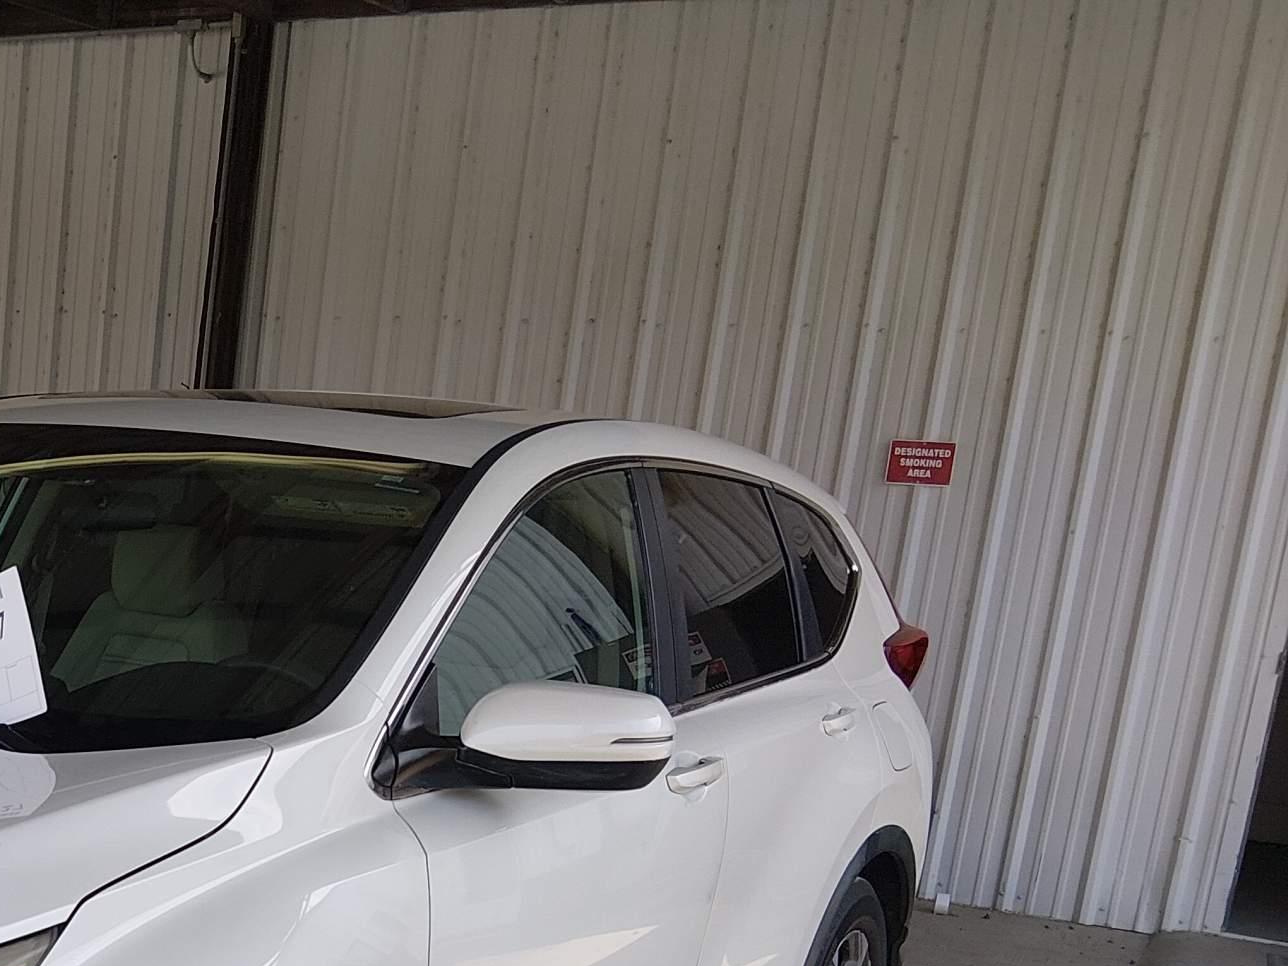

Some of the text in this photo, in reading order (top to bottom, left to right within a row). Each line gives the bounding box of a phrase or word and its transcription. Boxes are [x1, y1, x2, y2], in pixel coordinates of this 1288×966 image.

[894, 447, 952, 457] DESIGNATED
[900, 458, 942, 468] SMOKING
[907, 468, 931, 478] AREA
